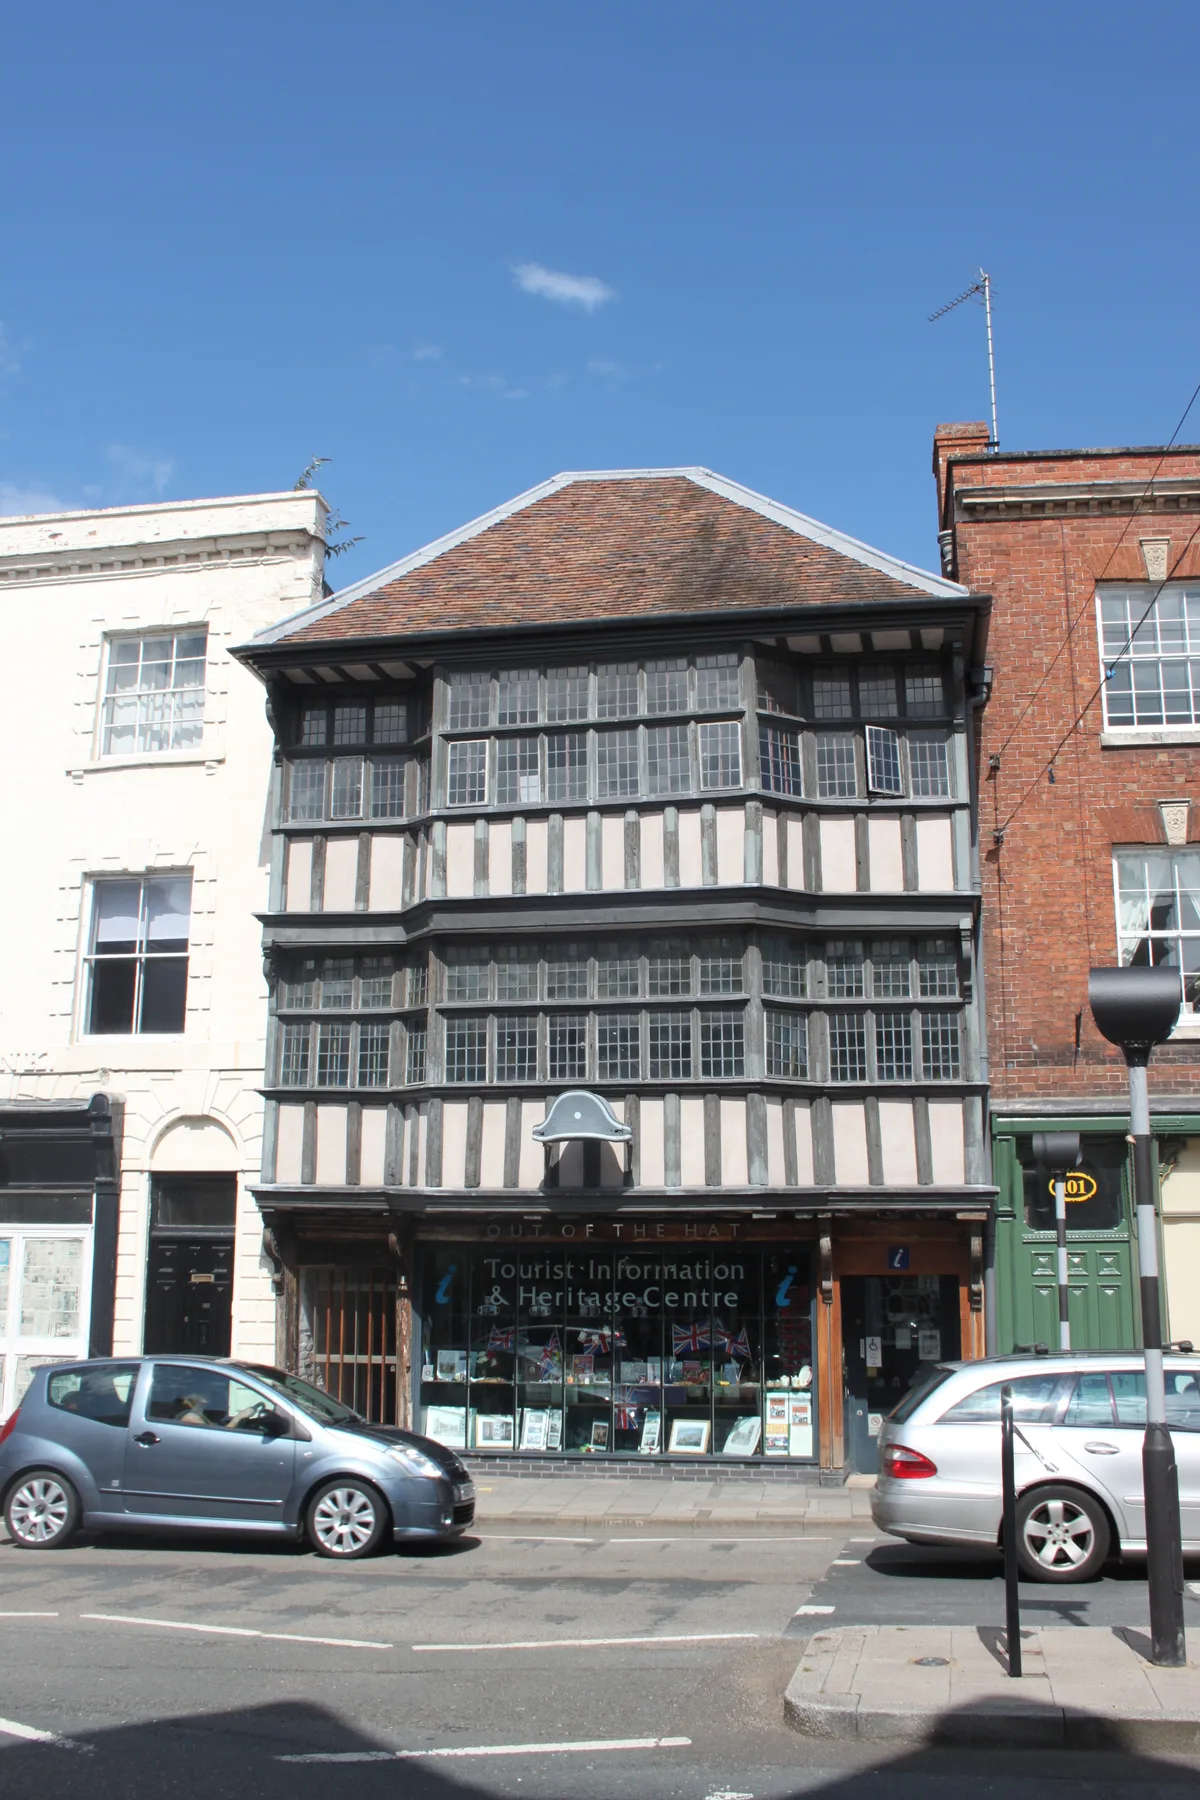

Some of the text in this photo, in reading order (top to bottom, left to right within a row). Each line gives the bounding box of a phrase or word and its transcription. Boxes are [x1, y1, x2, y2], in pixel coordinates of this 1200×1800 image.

[487, 1223, 740, 1238] OUT OF THE HAT
[486, 1259, 744, 1280] Tourist Information
[490, 1285, 738, 1312] & Heritage Centre
